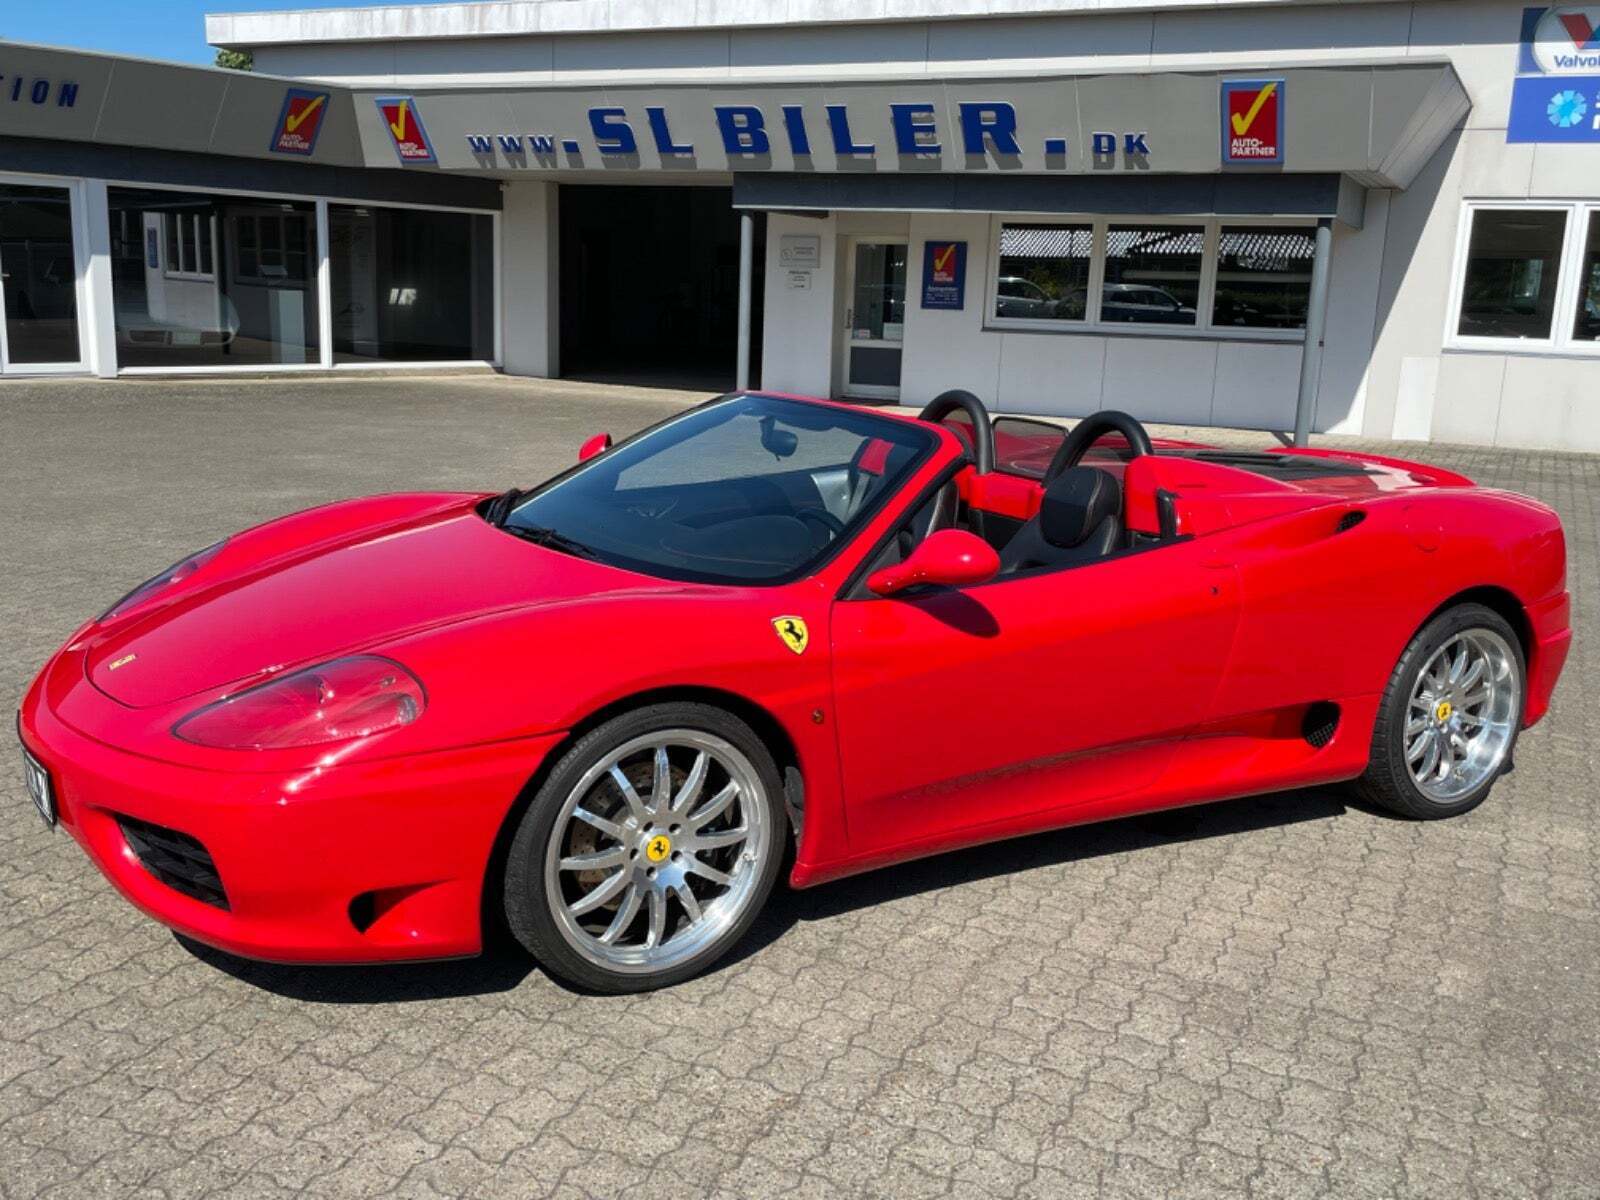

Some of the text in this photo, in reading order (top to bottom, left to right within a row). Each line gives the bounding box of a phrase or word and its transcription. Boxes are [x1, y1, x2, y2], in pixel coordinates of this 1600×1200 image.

[0, 75, 79, 107] ION
[1231, 138, 1263, 147] AUTO-
[1231, 147, 1276, 156] PARTNER
